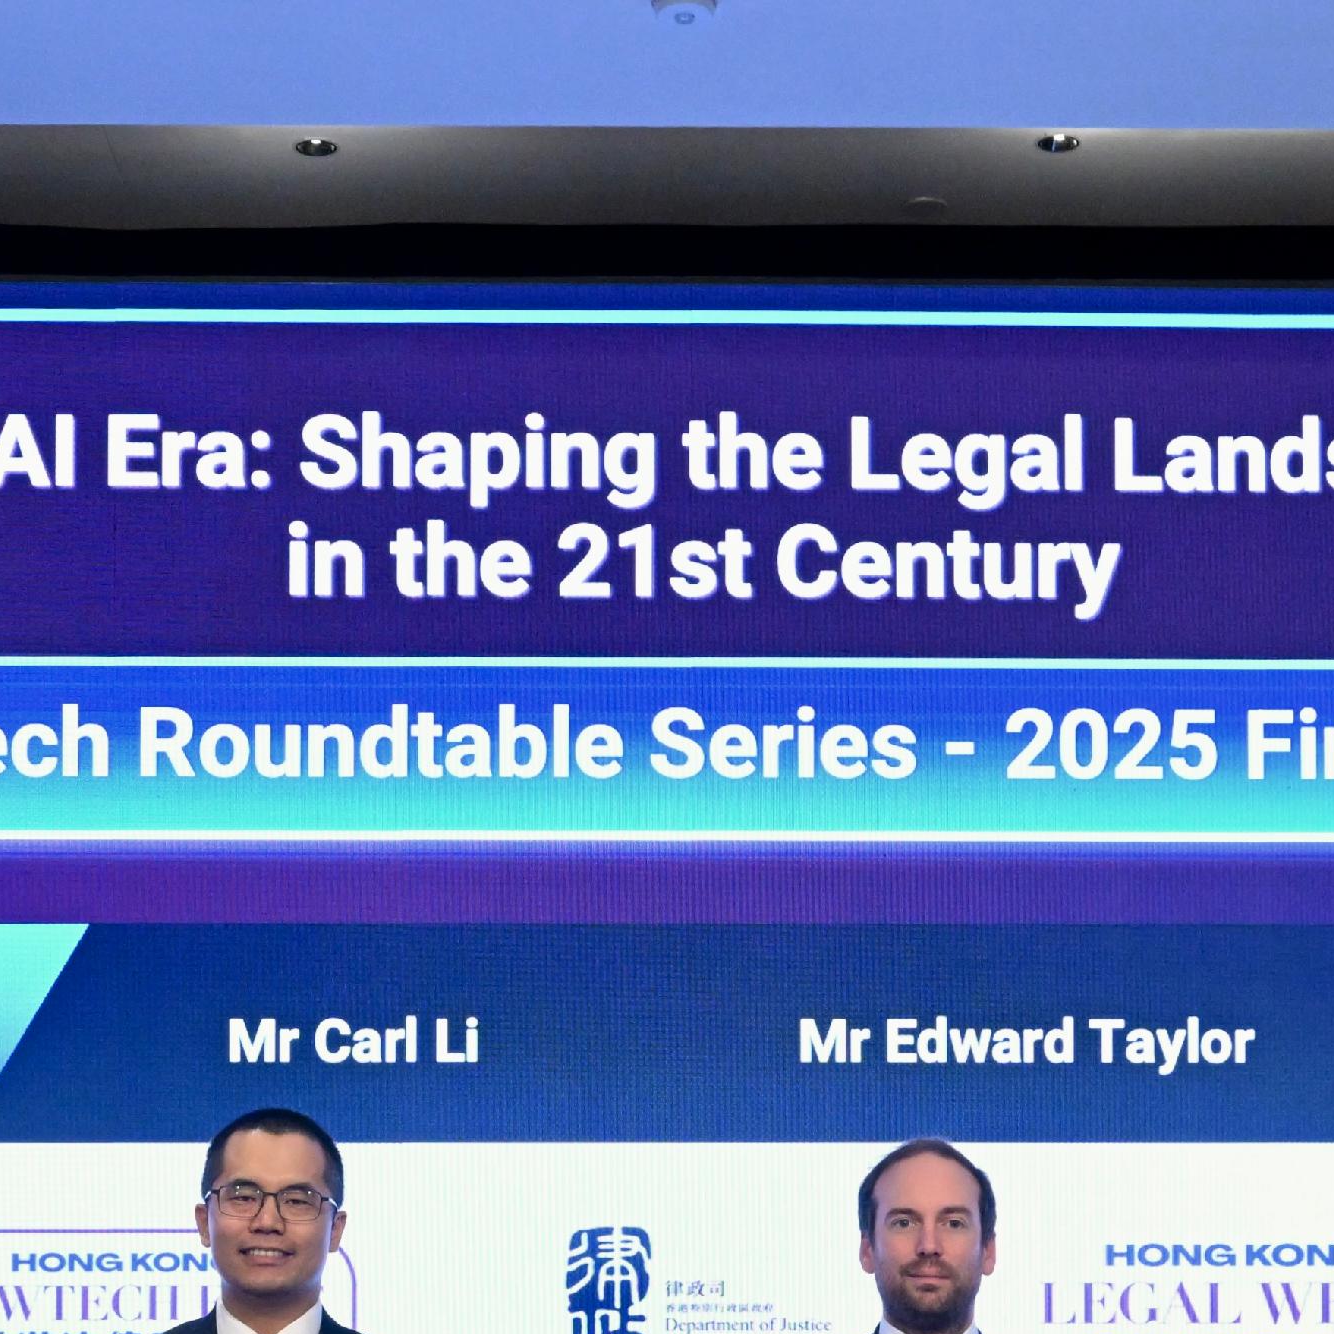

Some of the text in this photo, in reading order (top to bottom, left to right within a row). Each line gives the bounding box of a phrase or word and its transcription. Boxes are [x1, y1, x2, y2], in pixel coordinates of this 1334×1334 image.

[107, 414, 271, 489] Era:
[300, 411, 656, 510] Shaping
[682, 411, 824, 491] the
[851, 414, 1084, 511] Legal
[289, 519, 1123, 621] in the 21st Century
[140, 704, 623, 779] Roundtable
[650, 705, 916, 779] Series
[1006, 708, 1217, 780] 2025
[229, 1015, 478, 1063] Mr Carl Li
[800, 1015, 1255, 1075] Mr Edward Taylor
[12, 1252, 216, 1272] HONG KON
[1106, 1243, 1236, 1267] HONG
[666, 1317, 832, 1334] Department of Justice
[1045, 1282, 1241, 1324] LEGAL
